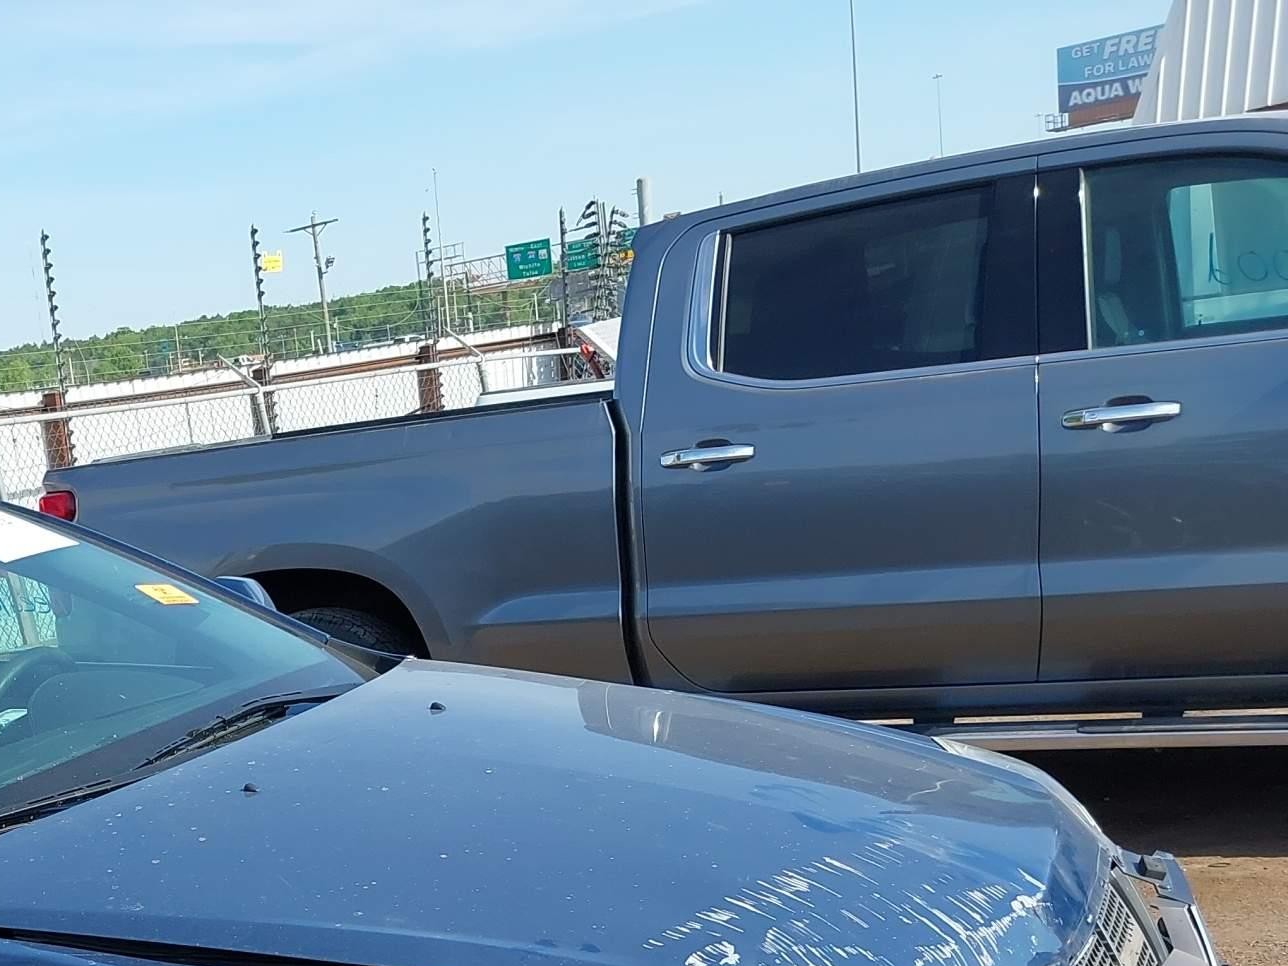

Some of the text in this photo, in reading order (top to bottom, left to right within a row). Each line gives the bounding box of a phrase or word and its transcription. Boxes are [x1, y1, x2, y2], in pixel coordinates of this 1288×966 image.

[1072, 30, 1161, 59] GET FRE
[1084, 62, 1115, 78] FOR
[1068, 82, 1125, 106] AQUA
